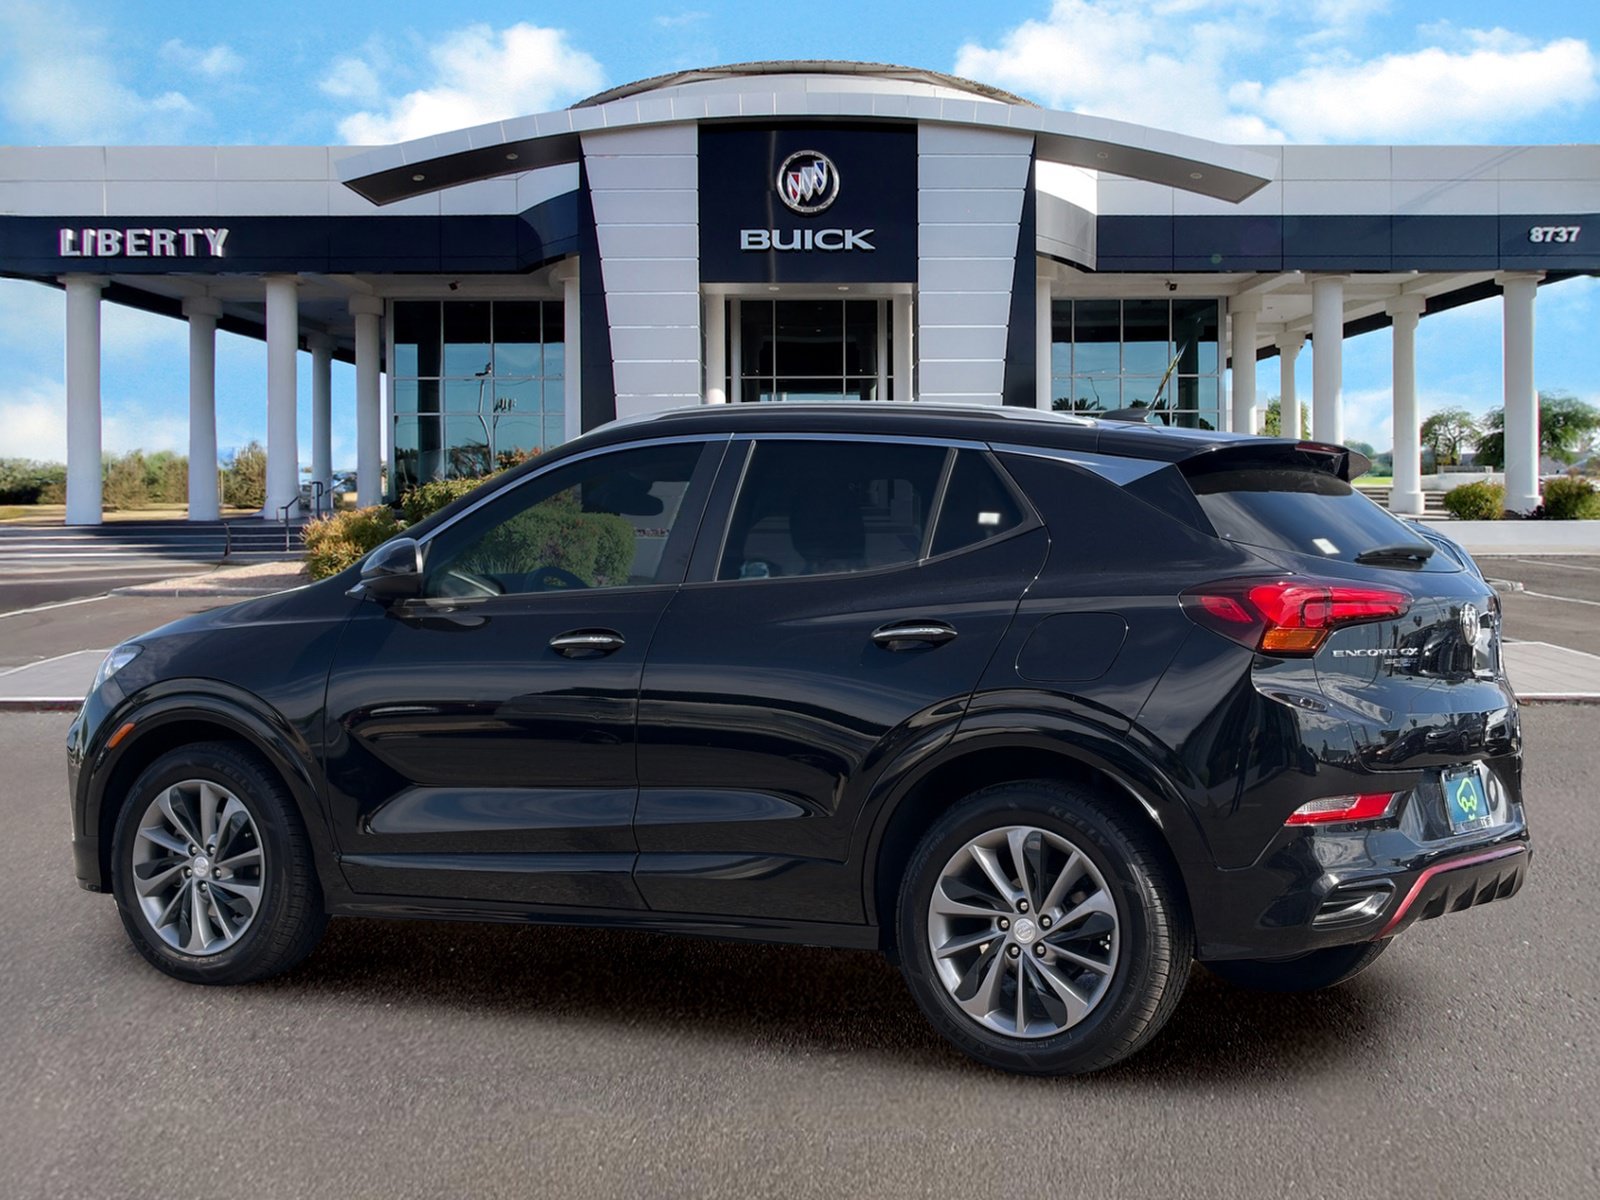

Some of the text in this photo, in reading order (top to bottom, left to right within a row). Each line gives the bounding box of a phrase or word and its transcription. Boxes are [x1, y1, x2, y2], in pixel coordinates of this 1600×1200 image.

[60, 228, 229, 257] LIBERTY
[740, 229, 876, 250] BUICK
[1529, 226, 1581, 243] 8737
[1332, 648, 1398, 658] ENCORE
[1047, 805, 1112, 847] KELLY
